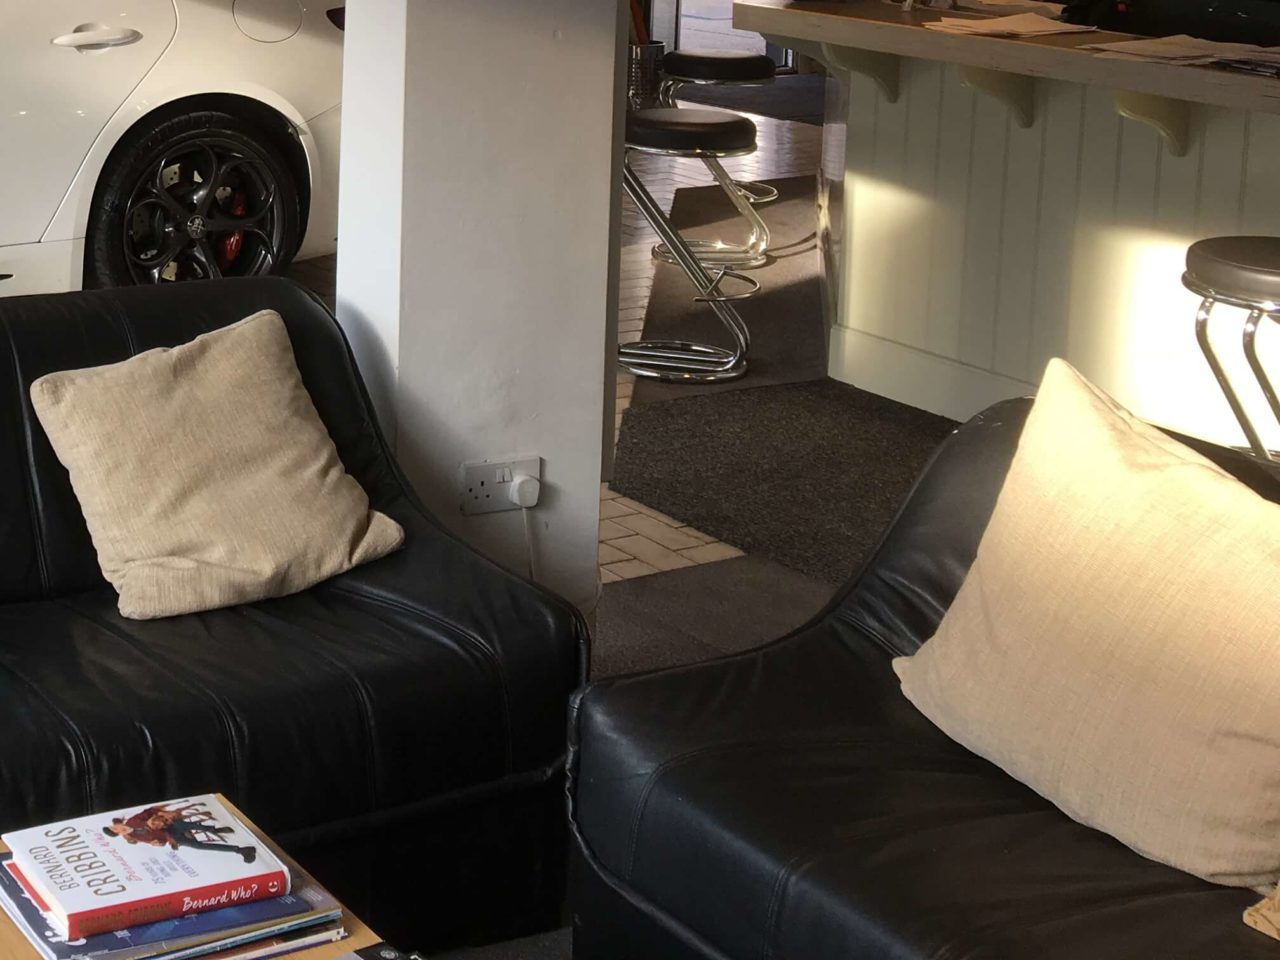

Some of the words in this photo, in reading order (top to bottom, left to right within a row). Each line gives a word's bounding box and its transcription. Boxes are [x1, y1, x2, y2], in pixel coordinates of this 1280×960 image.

[28, 845, 79, 891] BERNARD
[44, 826, 126, 896] CRIBBINS
[182, 889, 228, 912] Bernard
[230, 884, 259, 903] Who?
